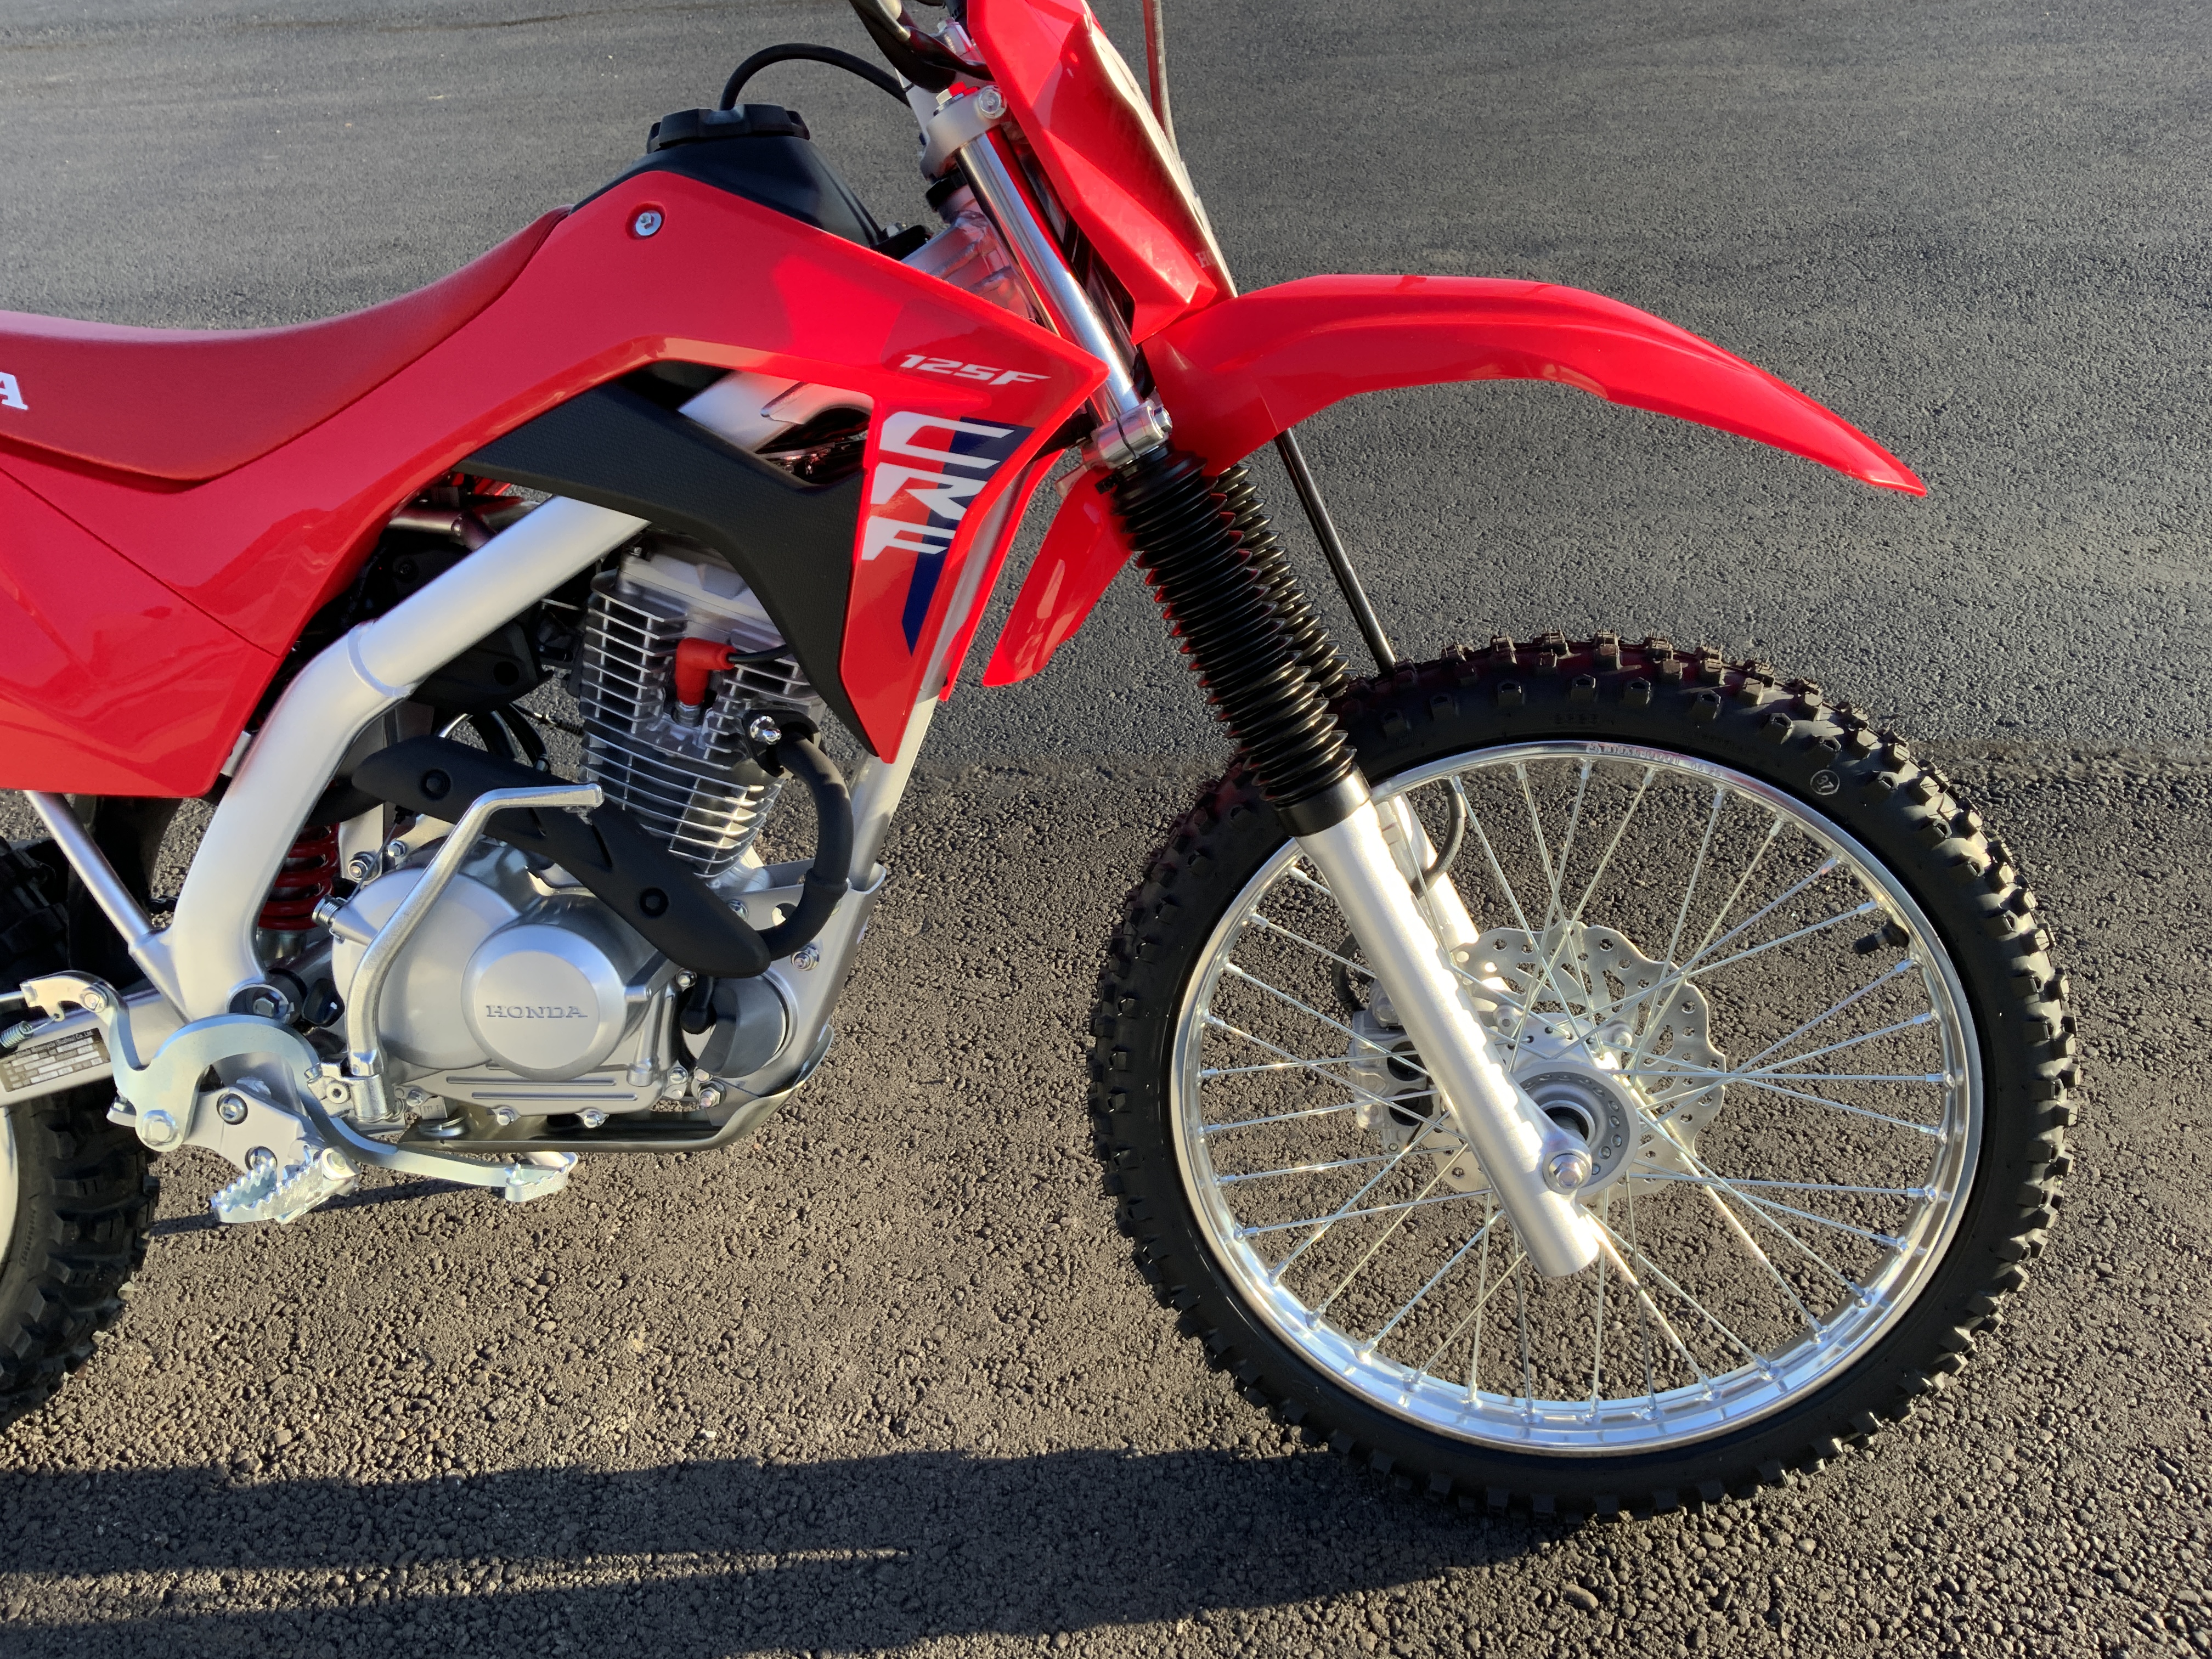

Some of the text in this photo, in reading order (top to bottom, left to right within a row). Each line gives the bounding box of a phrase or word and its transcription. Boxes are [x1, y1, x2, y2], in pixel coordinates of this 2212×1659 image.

[899, 354, 1052, 385] 125F
[861, 411, 1015, 561] CRF
[486, 1005, 588, 1018] HONDA
